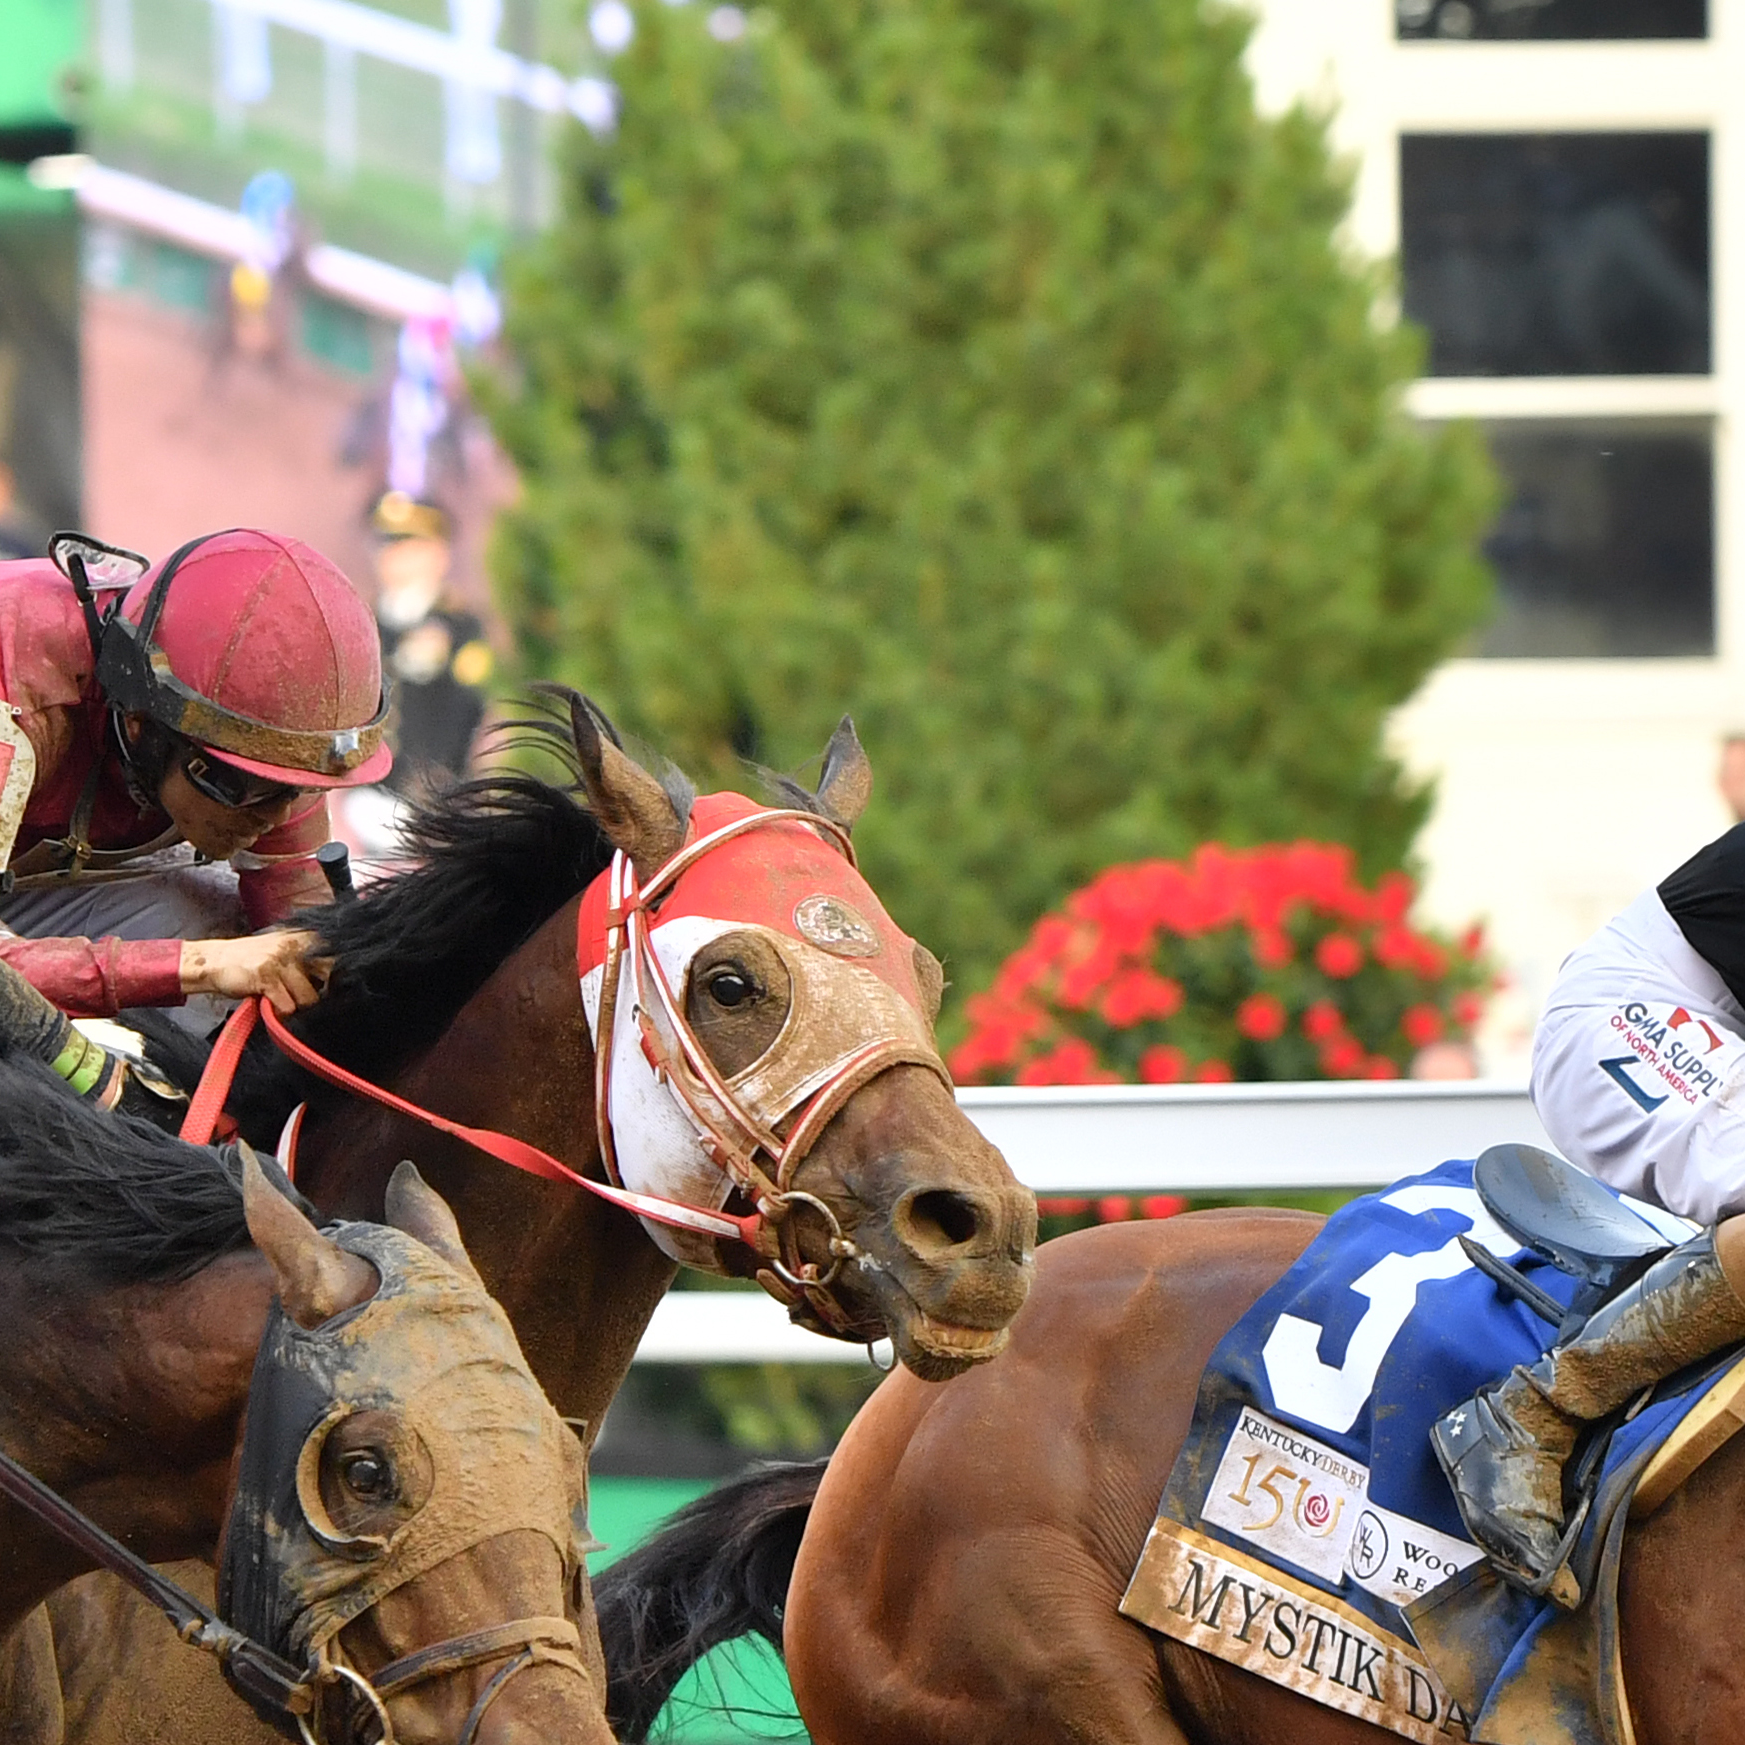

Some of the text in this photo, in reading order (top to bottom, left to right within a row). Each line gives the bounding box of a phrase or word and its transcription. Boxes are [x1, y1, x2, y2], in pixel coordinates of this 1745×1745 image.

[1610, 1015, 1628, 1032] OF
[1656, 1063, 1698, 1105] AMERICA
[1663, 1041, 1724, 1098] SUPPL
[1262, 1184, 1525, 1434] 3
[1239, 1414, 1366, 1490] KENTUCKY DERBY
[1167, 1559, 1385, 1703] MYSTIK
